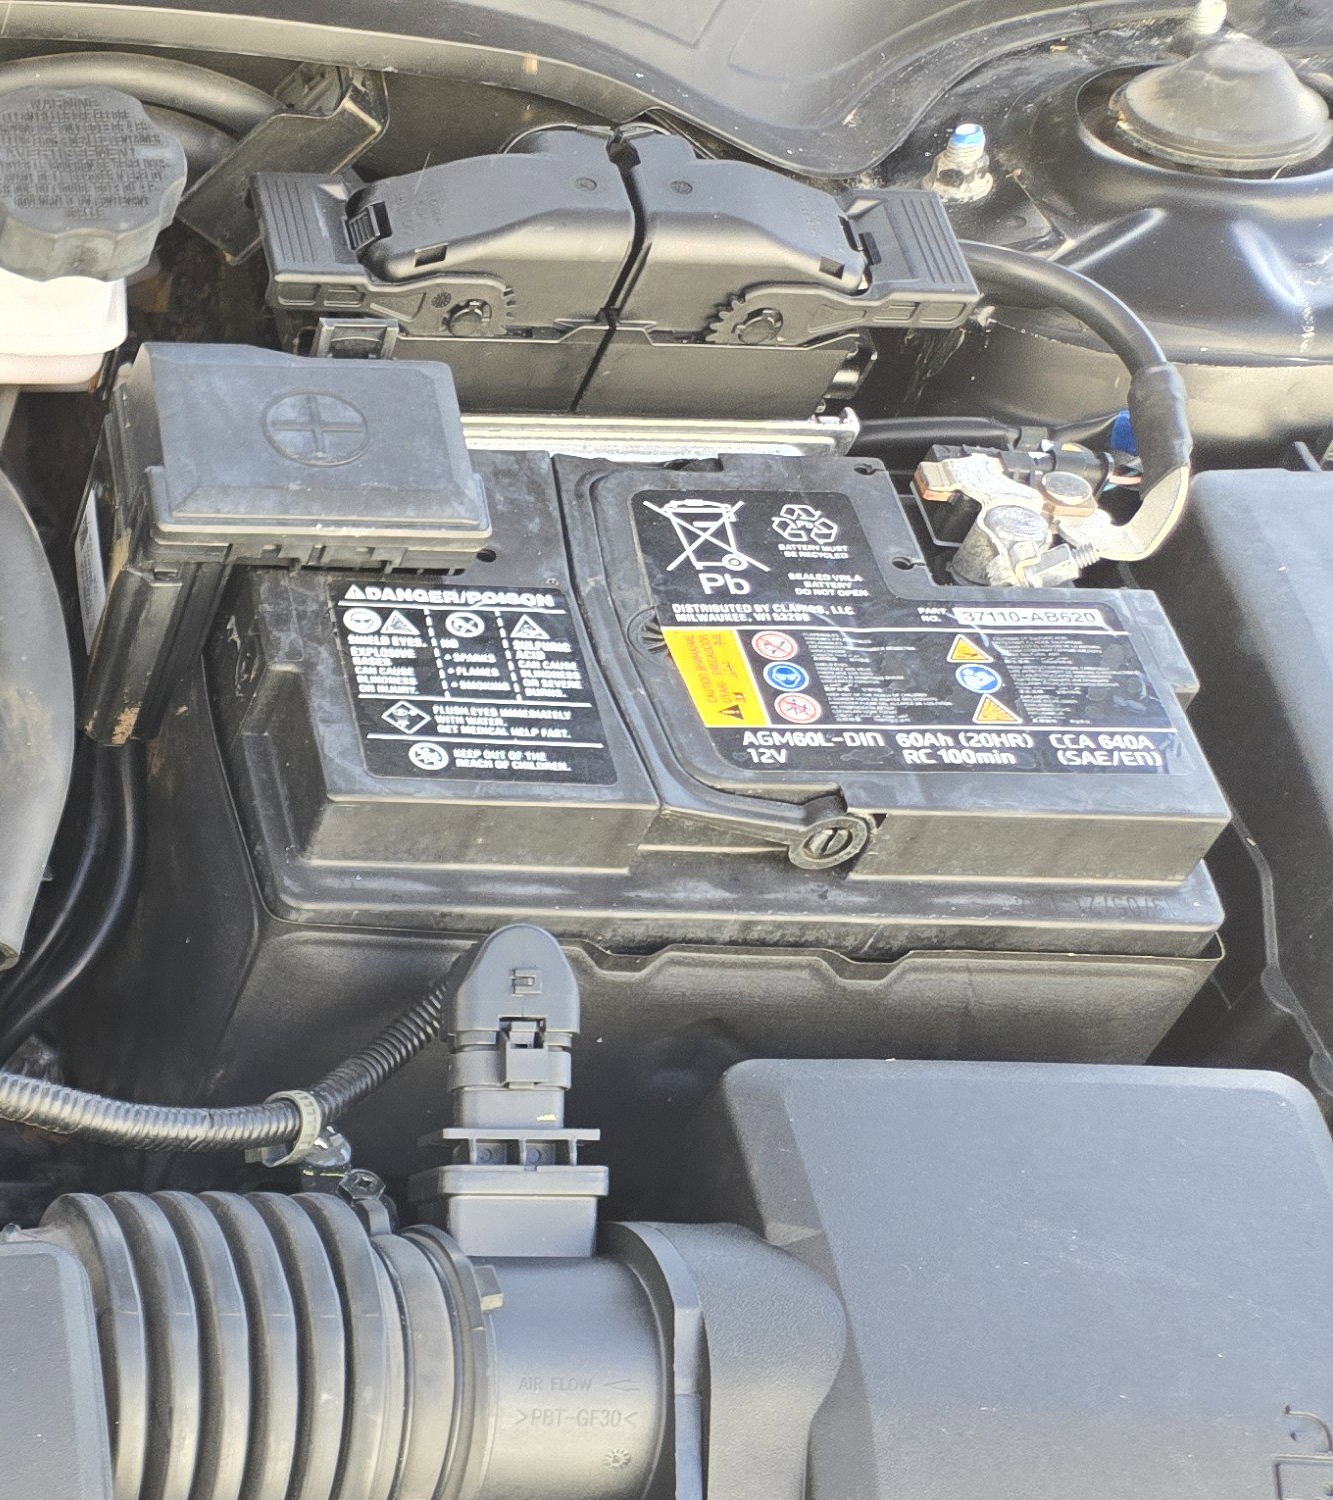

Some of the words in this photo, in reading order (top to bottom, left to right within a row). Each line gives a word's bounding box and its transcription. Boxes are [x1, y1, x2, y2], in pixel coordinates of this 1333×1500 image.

[799, 551, 849, 559] RECYCLED
[788, 573, 831, 581] SEALED
[832, 574, 863, 582] VRLA
[698, 573, 752, 595] Pb
[803, 581, 852, 589] BATTERY
[365, 586, 555, 607] DANGER/POISON
[795, 588, 812, 596] DO
[837, 589, 870, 597] OPEN
[672, 603, 752, 614] DISTRIBUTED
[753, 604, 770, 613] BY
[675, 612, 753, 623] MILWAUKEE,
[754, 613, 771, 622] WI
[961, 611, 1096, 623] 37110-AB620
[741, 731, 885, 747] AGM60L-DIN
[895, 732, 958, 748] 60Ah
[960, 733, 1033, 749] (20HR)
[1050, 734, 1096, 750] CCA
[1099, 735, 1155, 750] 640A
[746, 747, 787, 764] 12V
[903, 748, 937, 764] RC
[938, 749, 1017, 765] 100min
[1056, 749, 1162, 767] (SAE/EN)
[518, 1377, 543, 1390] AIR
[550, 1377, 592, 1391] FLOW
